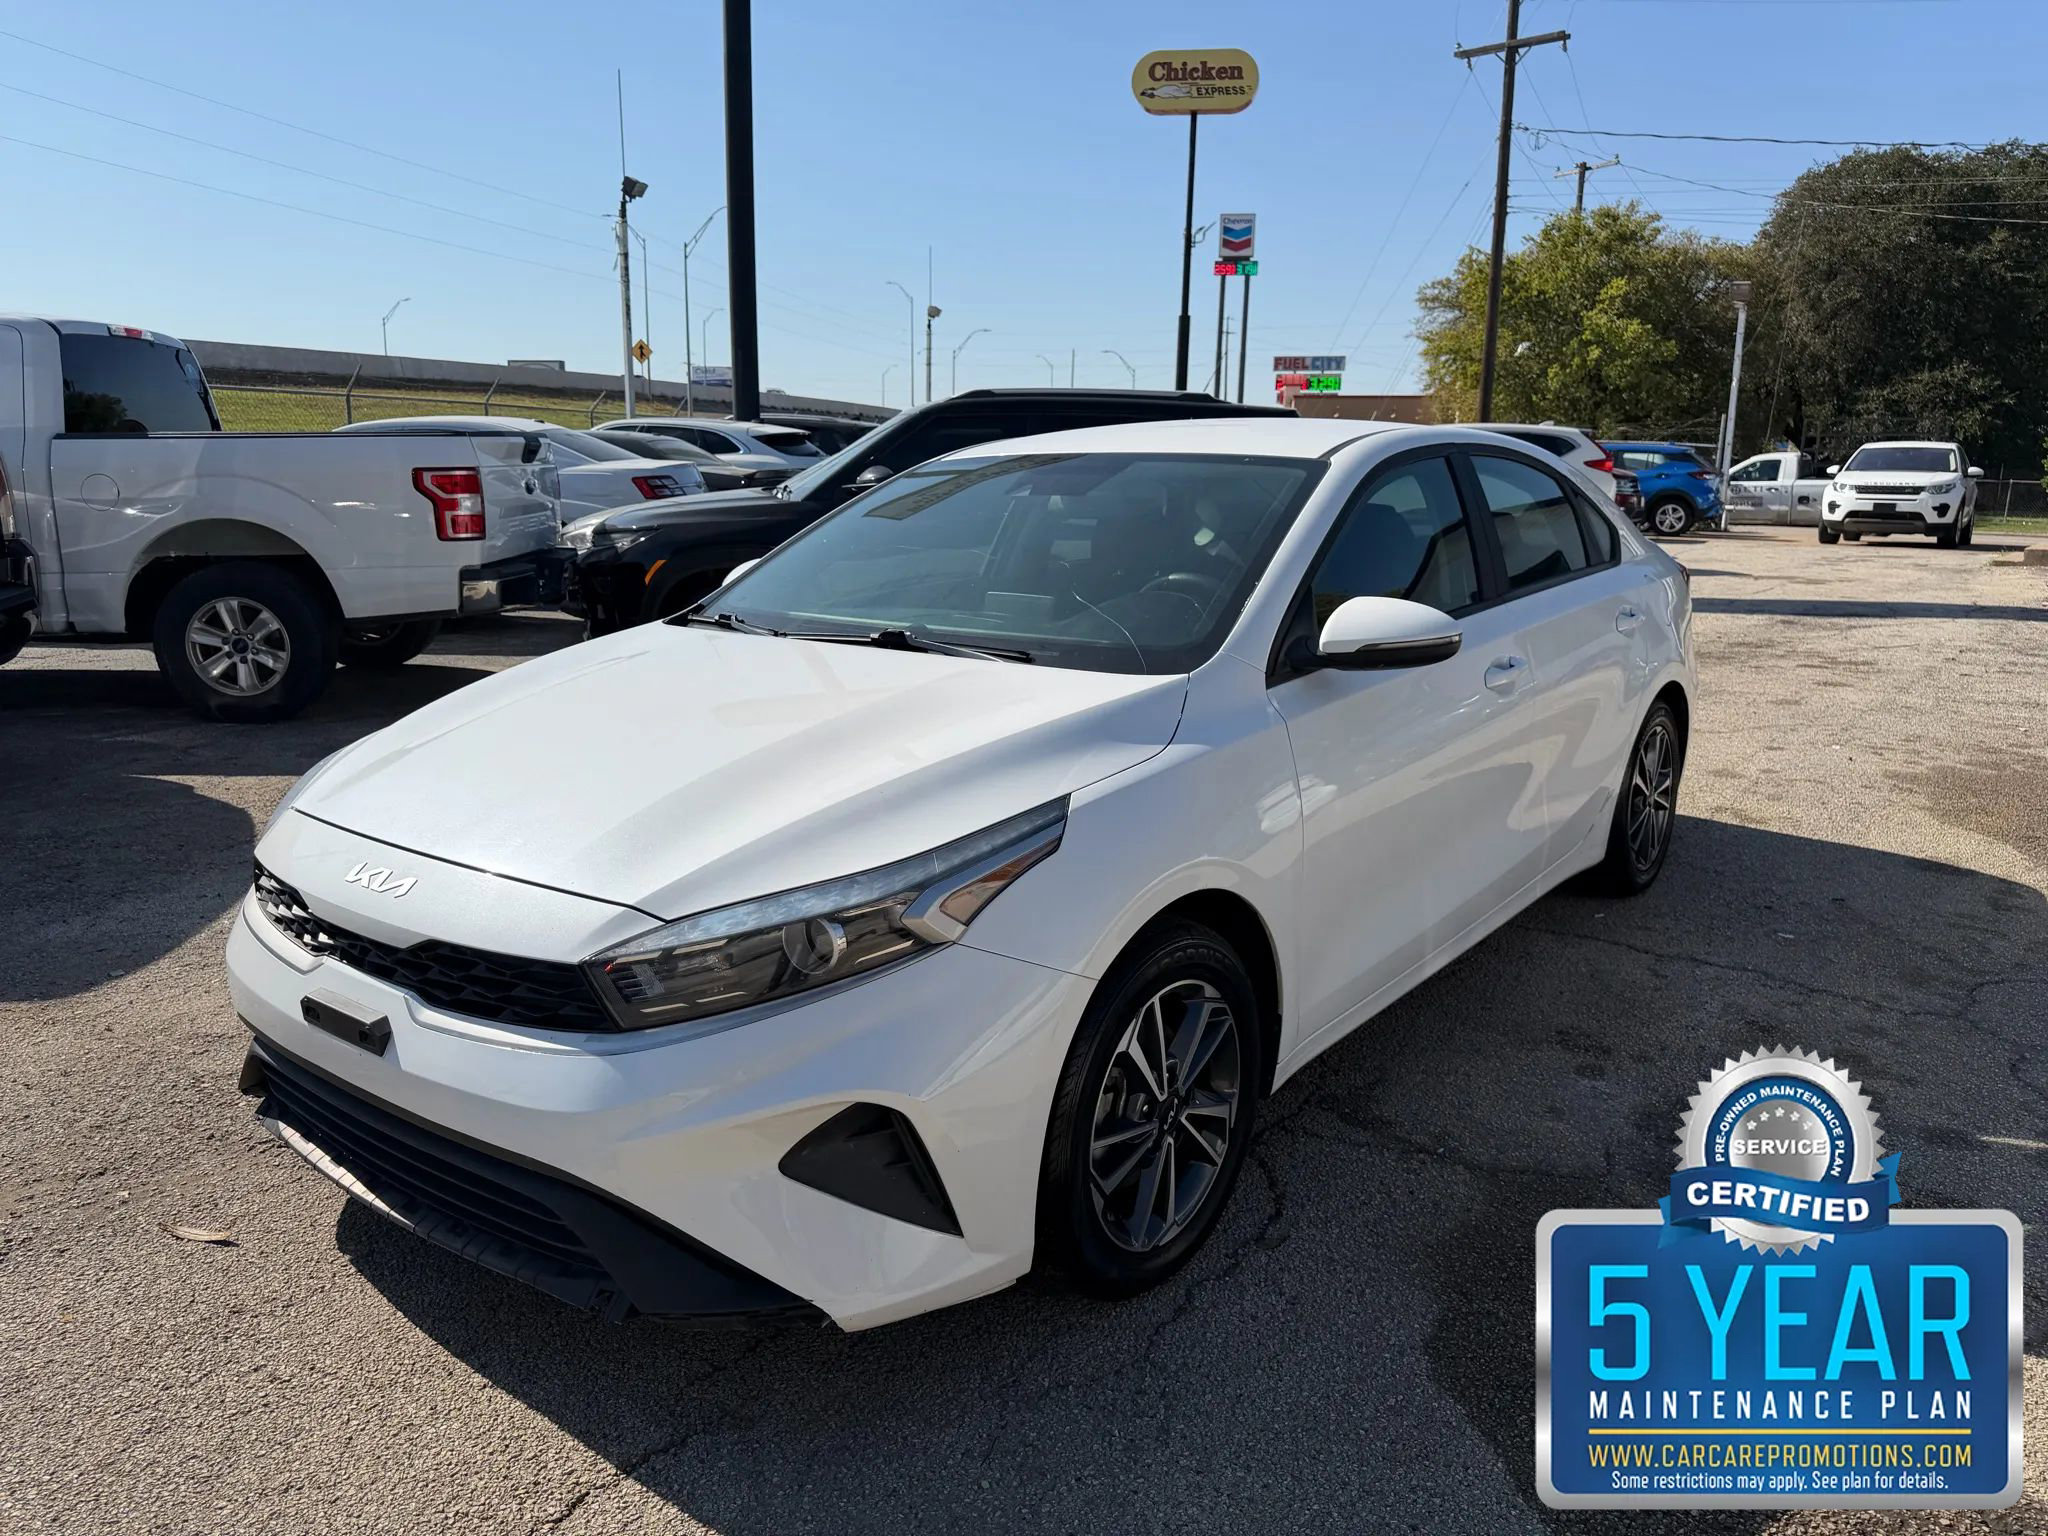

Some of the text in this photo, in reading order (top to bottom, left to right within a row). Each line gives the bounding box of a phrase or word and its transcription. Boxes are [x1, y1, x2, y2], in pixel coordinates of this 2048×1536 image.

[1148, 61, 1244, 81] Chicken
[1196, 86, 1246, 96] EXPRESS
[1275, 357, 1343, 370] FUEL CITY
[344, 861, 418, 898] KIA
